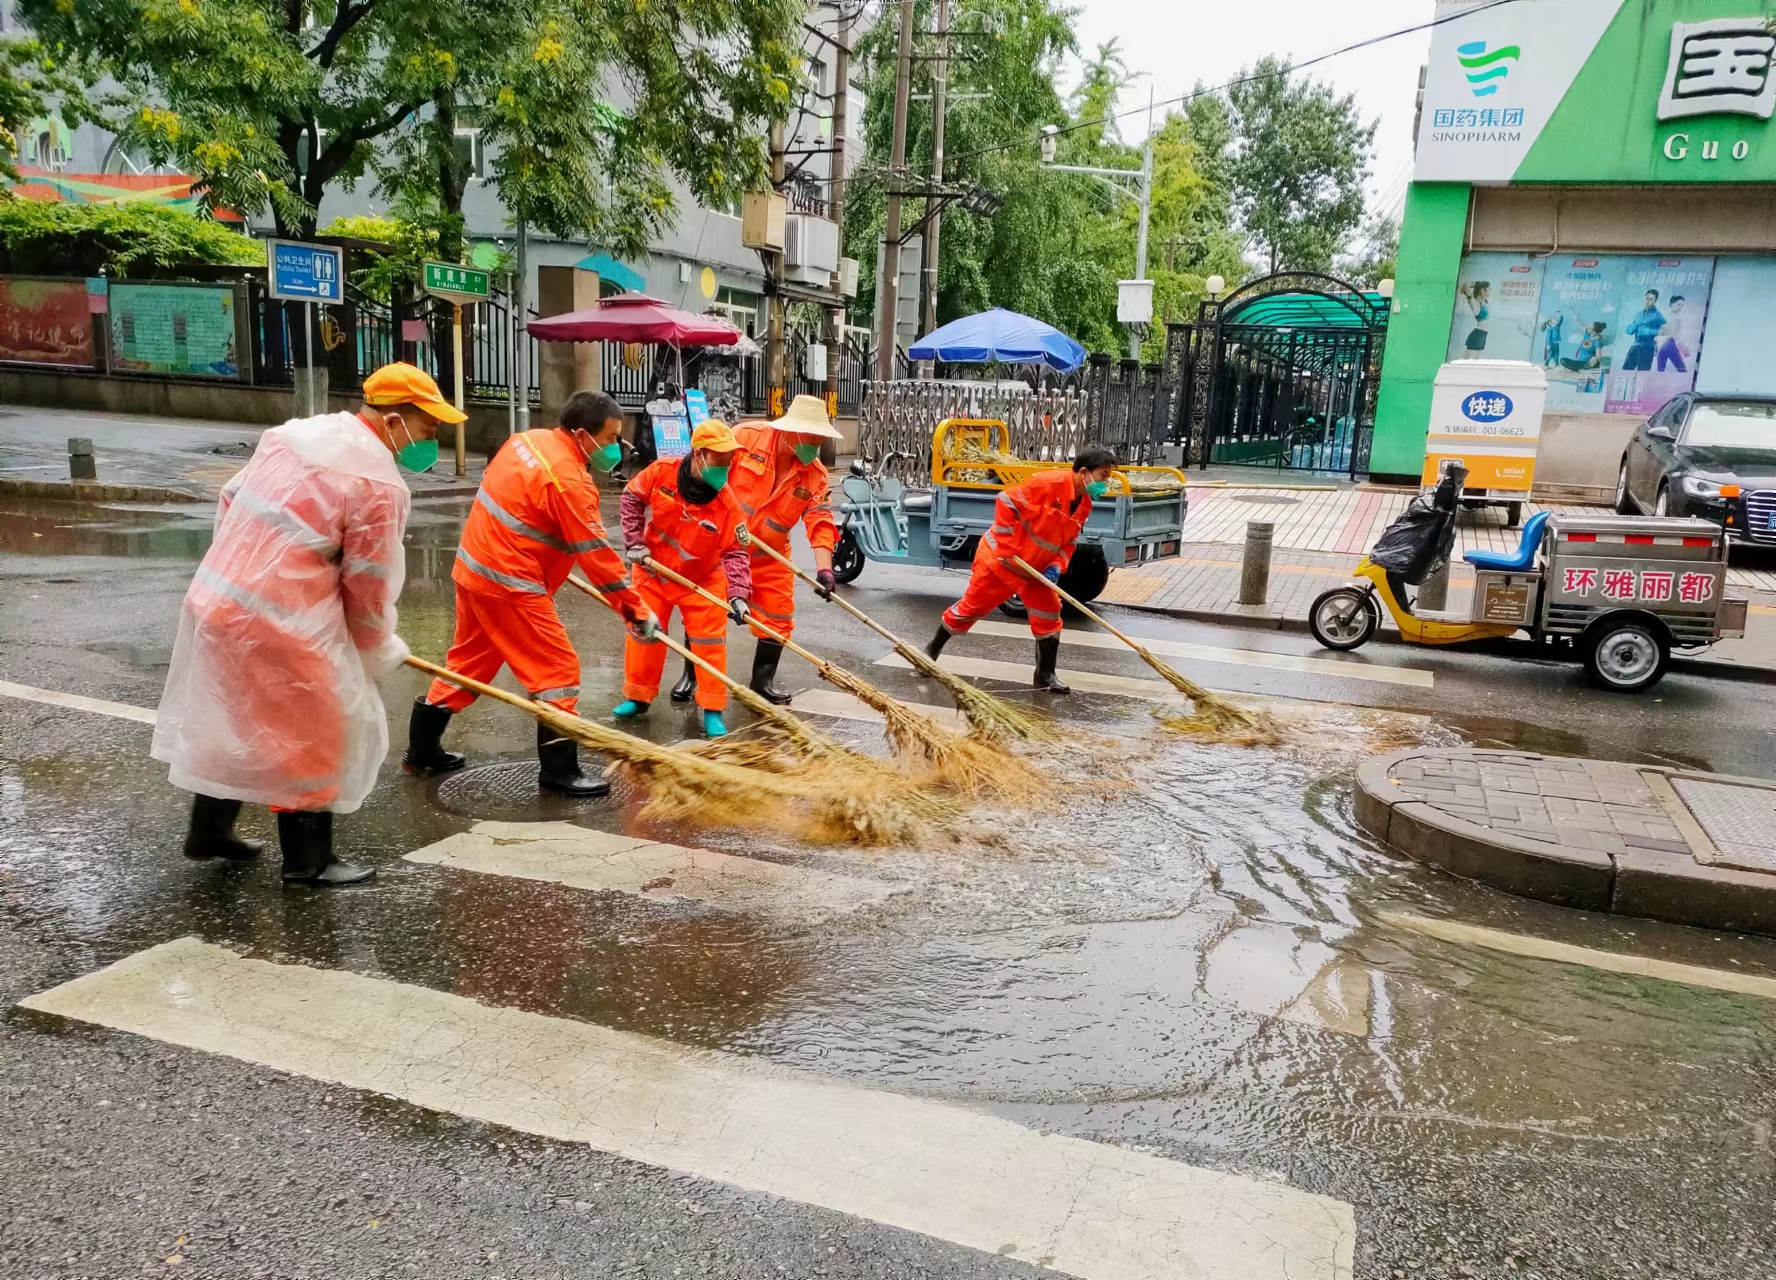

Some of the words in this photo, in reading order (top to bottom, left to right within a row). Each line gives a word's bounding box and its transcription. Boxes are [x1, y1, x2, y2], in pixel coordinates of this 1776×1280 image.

[1657, 18, 1776, 121] 国
[1433, 107, 1524, 128] 国药集团
[1431, 131, 1521, 142] SINOPHARM
[1663, 133, 1749, 160] Guo
[276, 254, 312, 267] 公共卫生间
[277, 263, 296, 272] Public
[433, 267, 467, 284] 新建里
[1467, 396, 1507, 417] 快递
[1562, 567, 1715, 604] 环雅丽都
